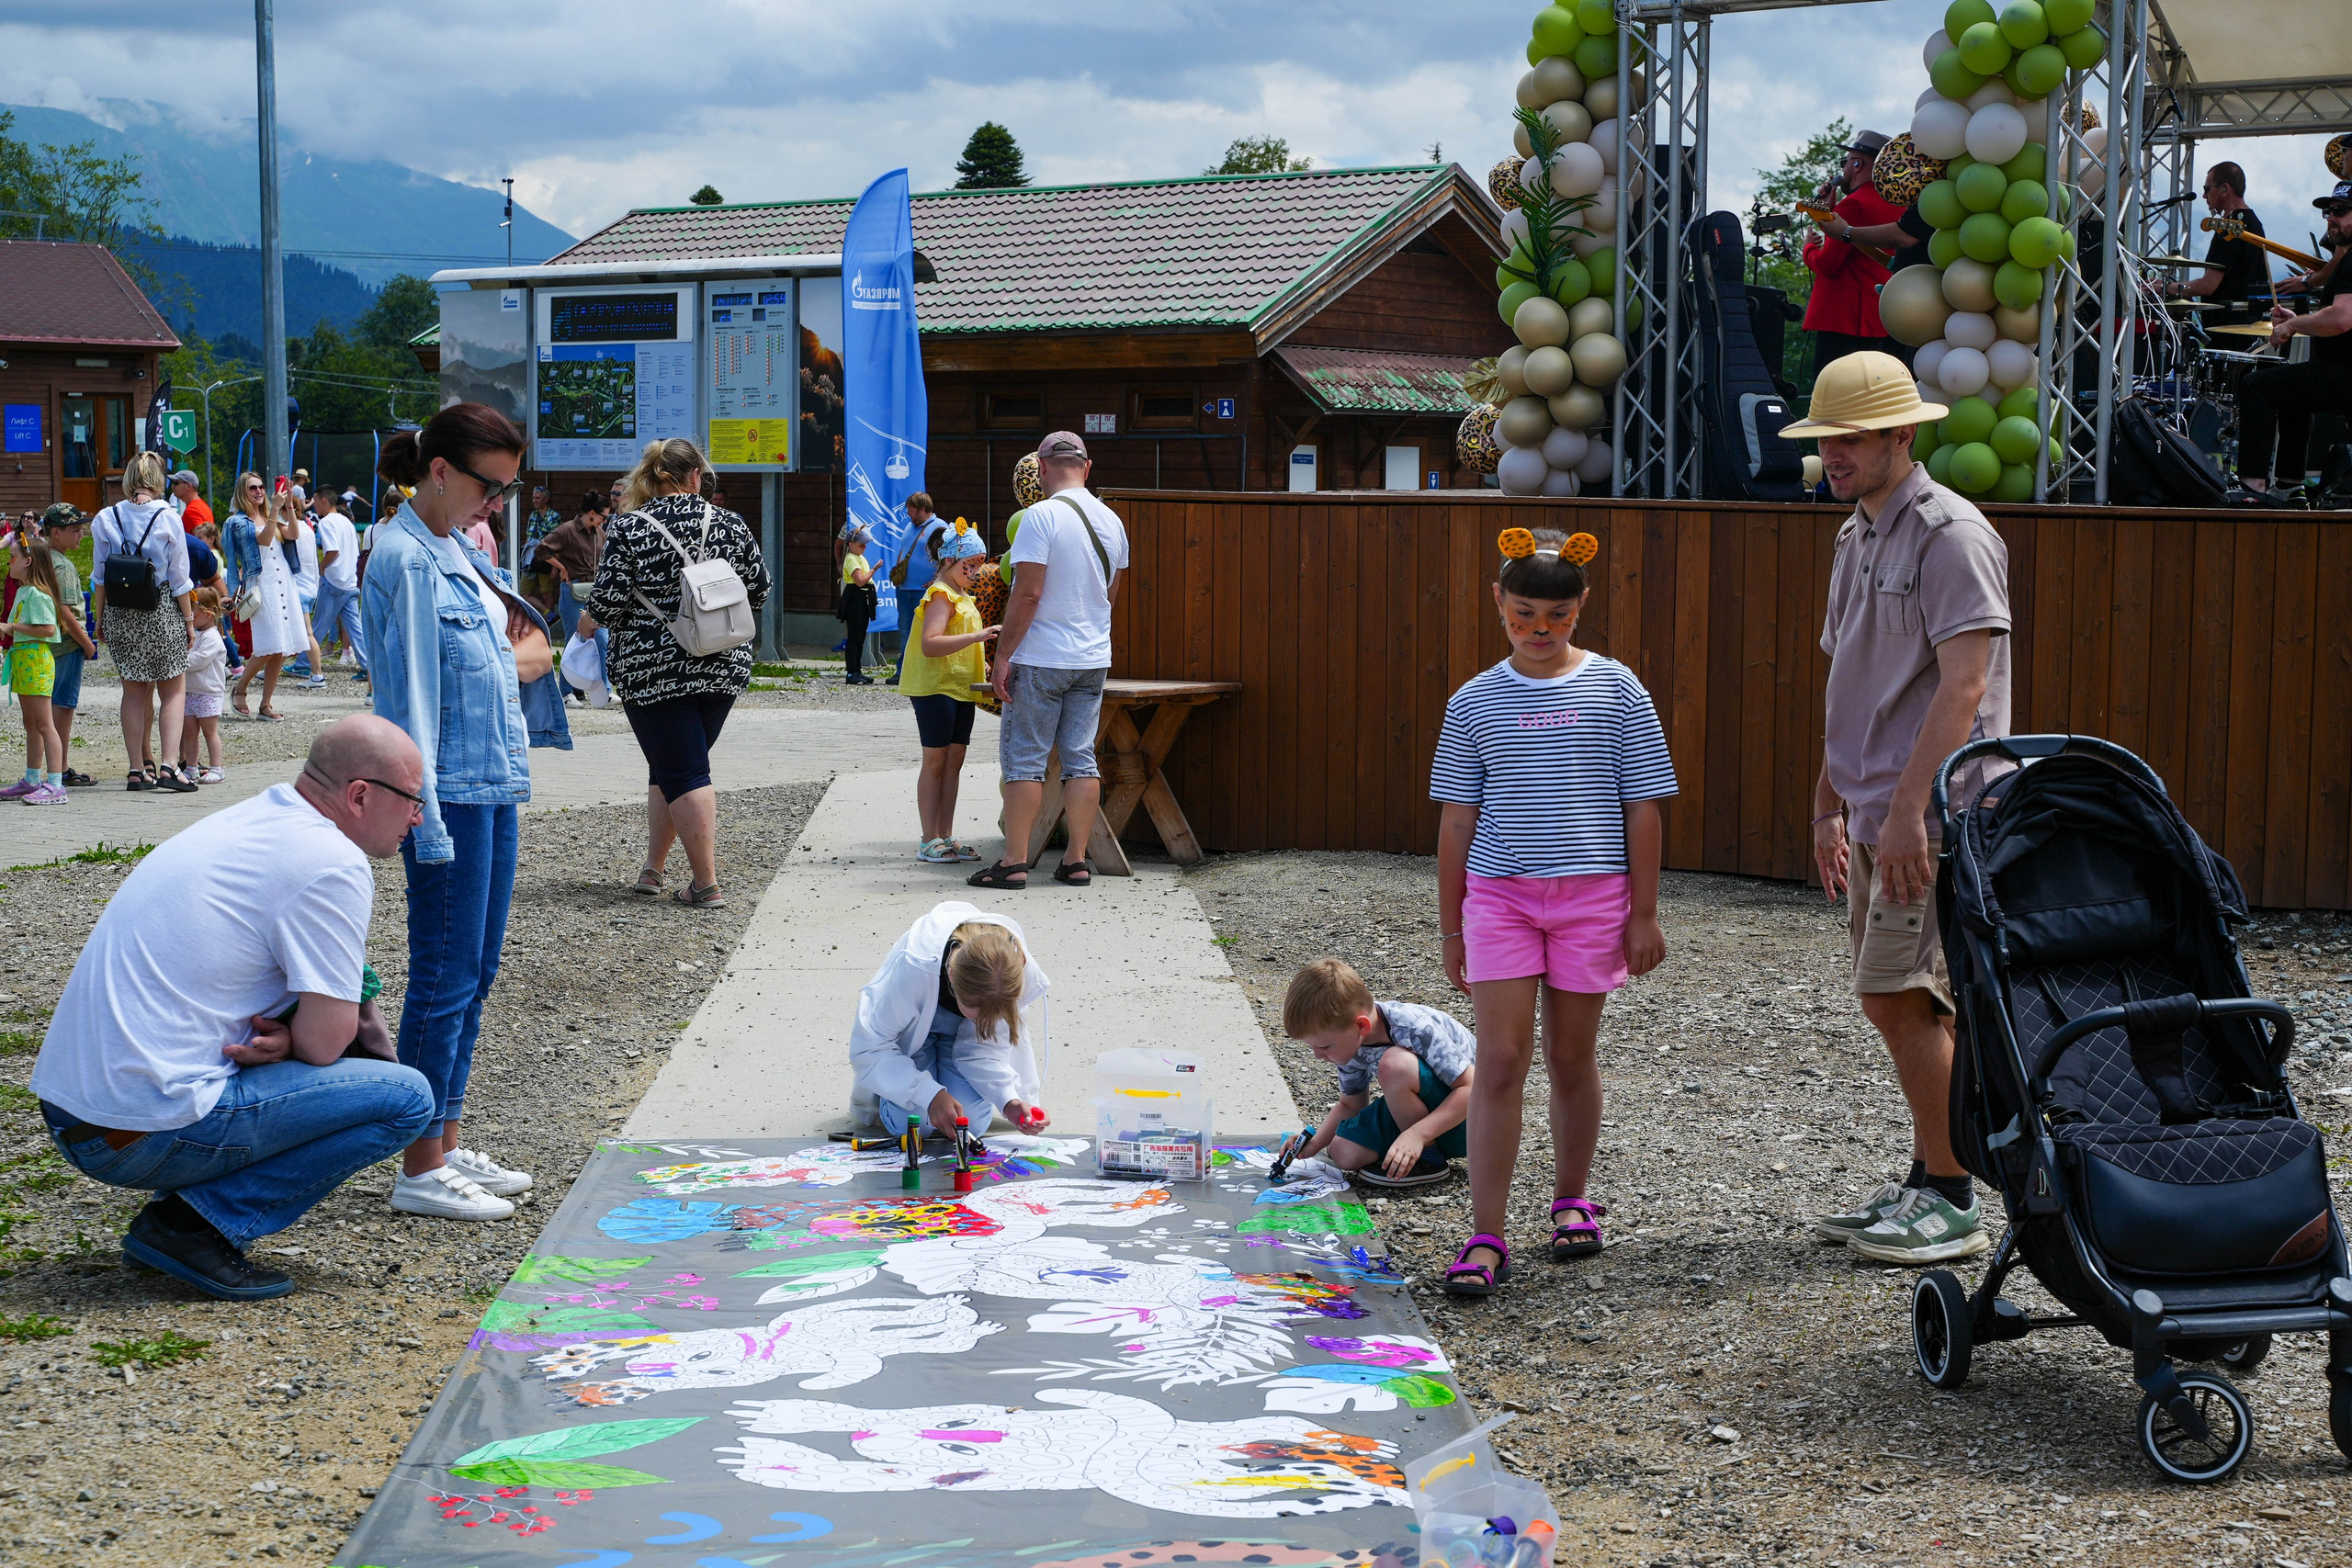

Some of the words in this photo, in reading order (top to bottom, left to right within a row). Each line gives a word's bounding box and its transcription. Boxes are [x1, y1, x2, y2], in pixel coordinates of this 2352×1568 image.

[863, 288, 900, 299] ГАЗПРОМ
[11, 417, 28, 425] Лифт
[15, 432, 24, 440] Lift
[1519, 709, 1579, 728] GOOD
